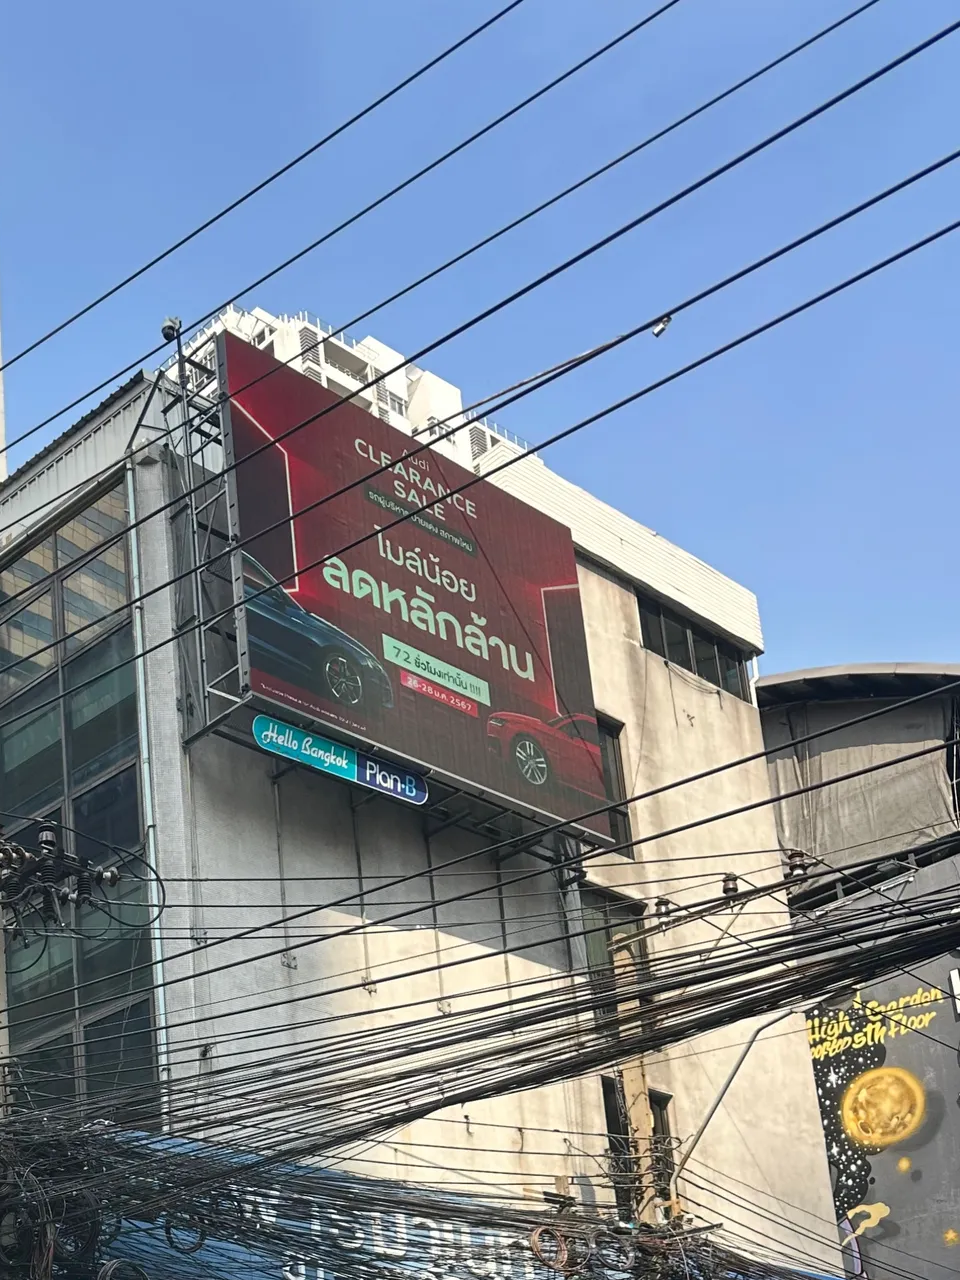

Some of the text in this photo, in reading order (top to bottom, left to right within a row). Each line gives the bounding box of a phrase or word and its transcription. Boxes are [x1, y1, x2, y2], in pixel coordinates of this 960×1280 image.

[354, 438, 477, 519] CLEARANCE
[402, 449, 430, 472] Audi
[393, 480, 446, 521] SALE
[373, 523, 477, 602] ไมล์น้อย
[322, 554, 536, 682] ลดหลักล้าน
[392, 645, 412, 665] 72
[261, 722, 349, 769] Hello Bangkok
[810, 1035, 852, 1061] ooftop
